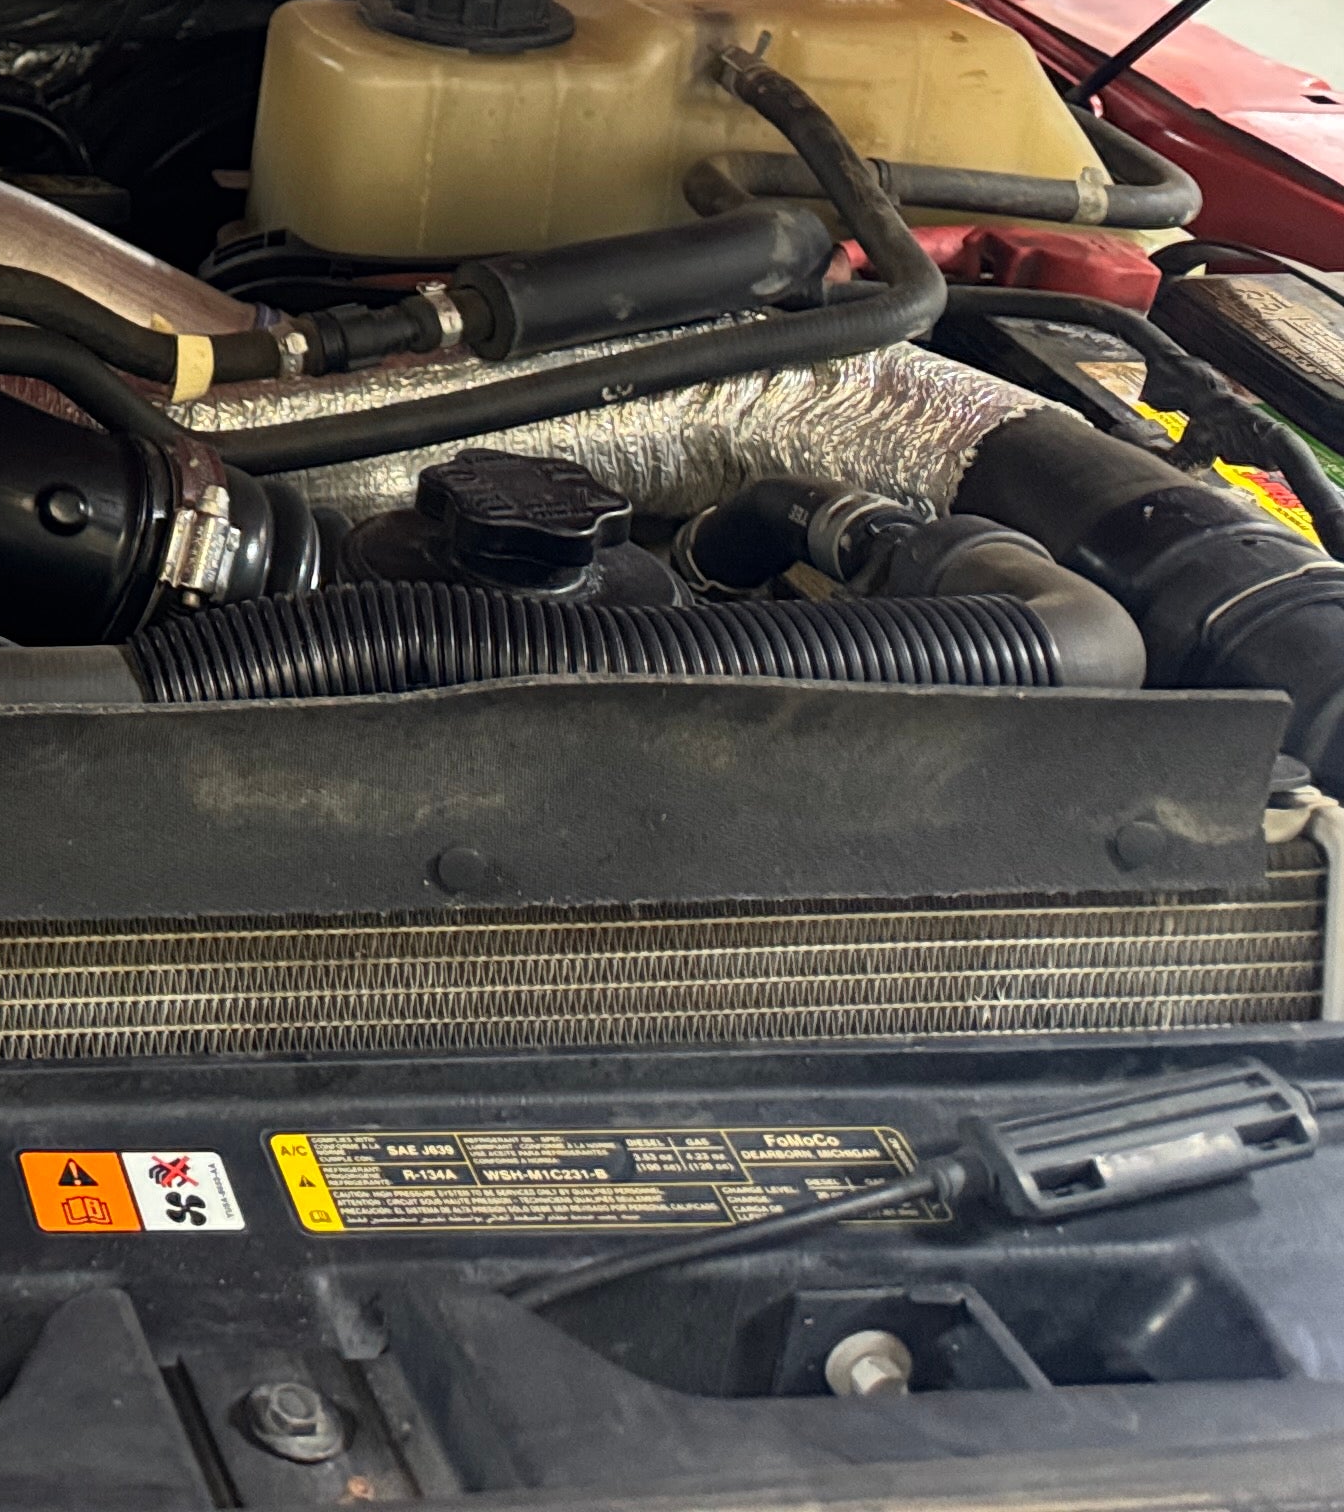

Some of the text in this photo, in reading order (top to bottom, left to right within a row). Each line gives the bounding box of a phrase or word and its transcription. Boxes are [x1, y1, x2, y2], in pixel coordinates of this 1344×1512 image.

[625, 1139, 665, 1147] DIESEL
[281, 1145, 309, 1157] A/C
[386, 1145, 418, 1157] SAE
[422, 1144, 455, 1156] J639
[817, 1148, 881, 1159] MICHIGAN
[402, 1169, 458, 1181] R-134A
[482, 1168, 609, 1181] WSH-M1C231-B
